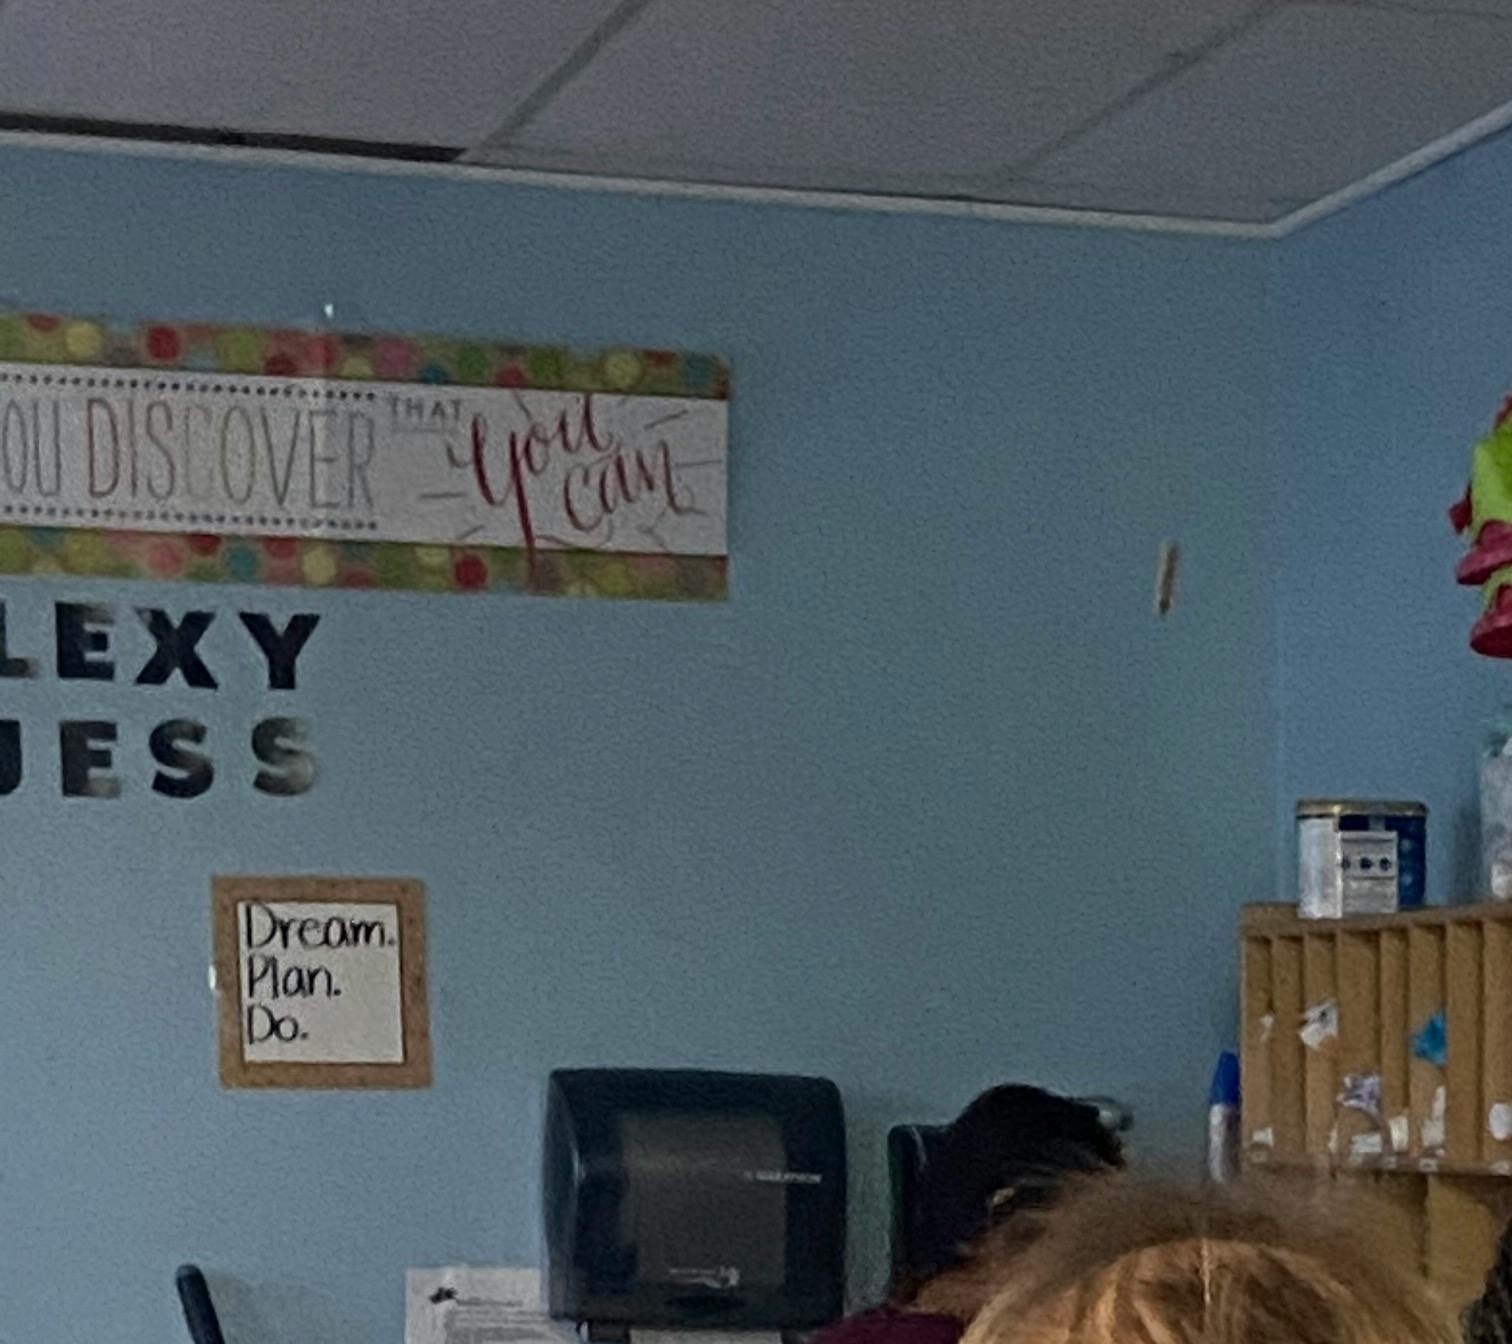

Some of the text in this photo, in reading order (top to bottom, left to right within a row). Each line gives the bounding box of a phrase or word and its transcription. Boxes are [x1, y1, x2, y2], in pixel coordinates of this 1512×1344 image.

[86, 397, 375, 510] DISCOVER
[388, 396, 464, 424] THAT
[245, 898, 397, 949] Dream.
[248, 953, 342, 999] Plan.
[247, 1002, 309, 1045] Do.
